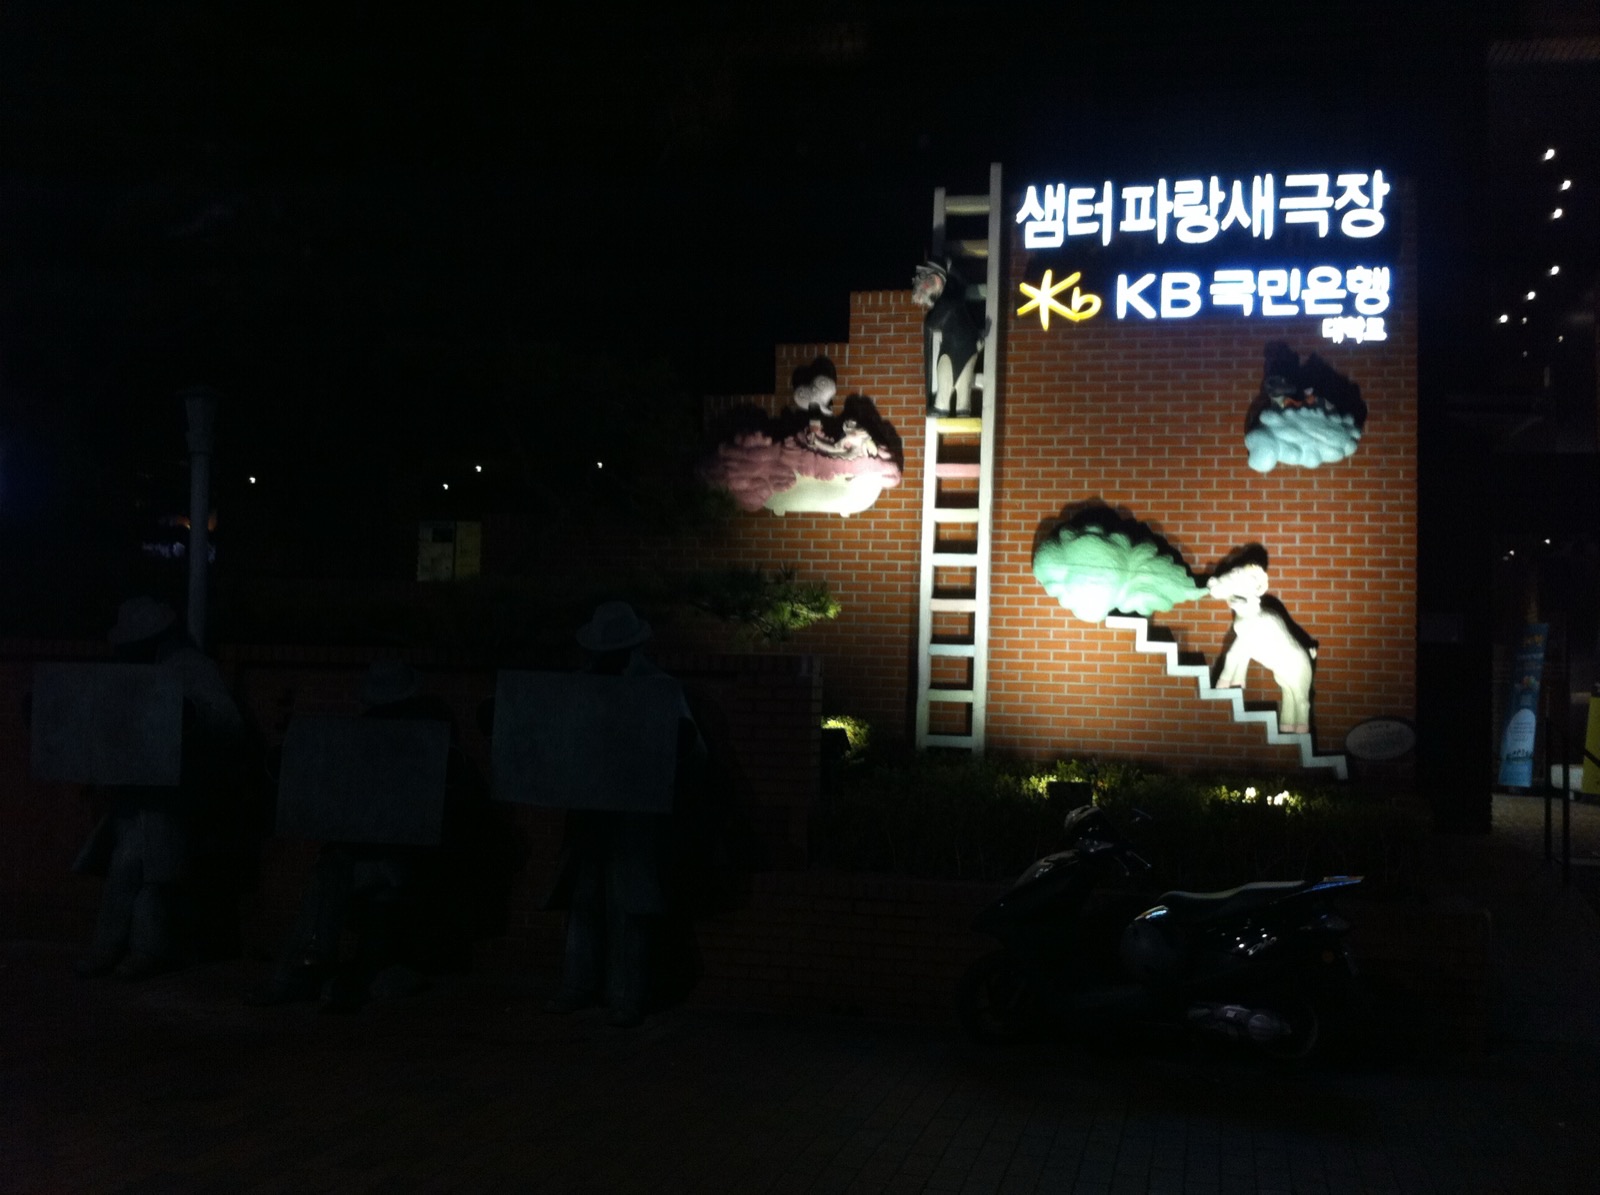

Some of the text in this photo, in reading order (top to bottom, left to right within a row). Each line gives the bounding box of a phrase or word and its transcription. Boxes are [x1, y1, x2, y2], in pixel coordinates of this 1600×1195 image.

[1015, 180, 1113, 249] 샘터
[1116, 265, 1391, 320] KB 국민은행
